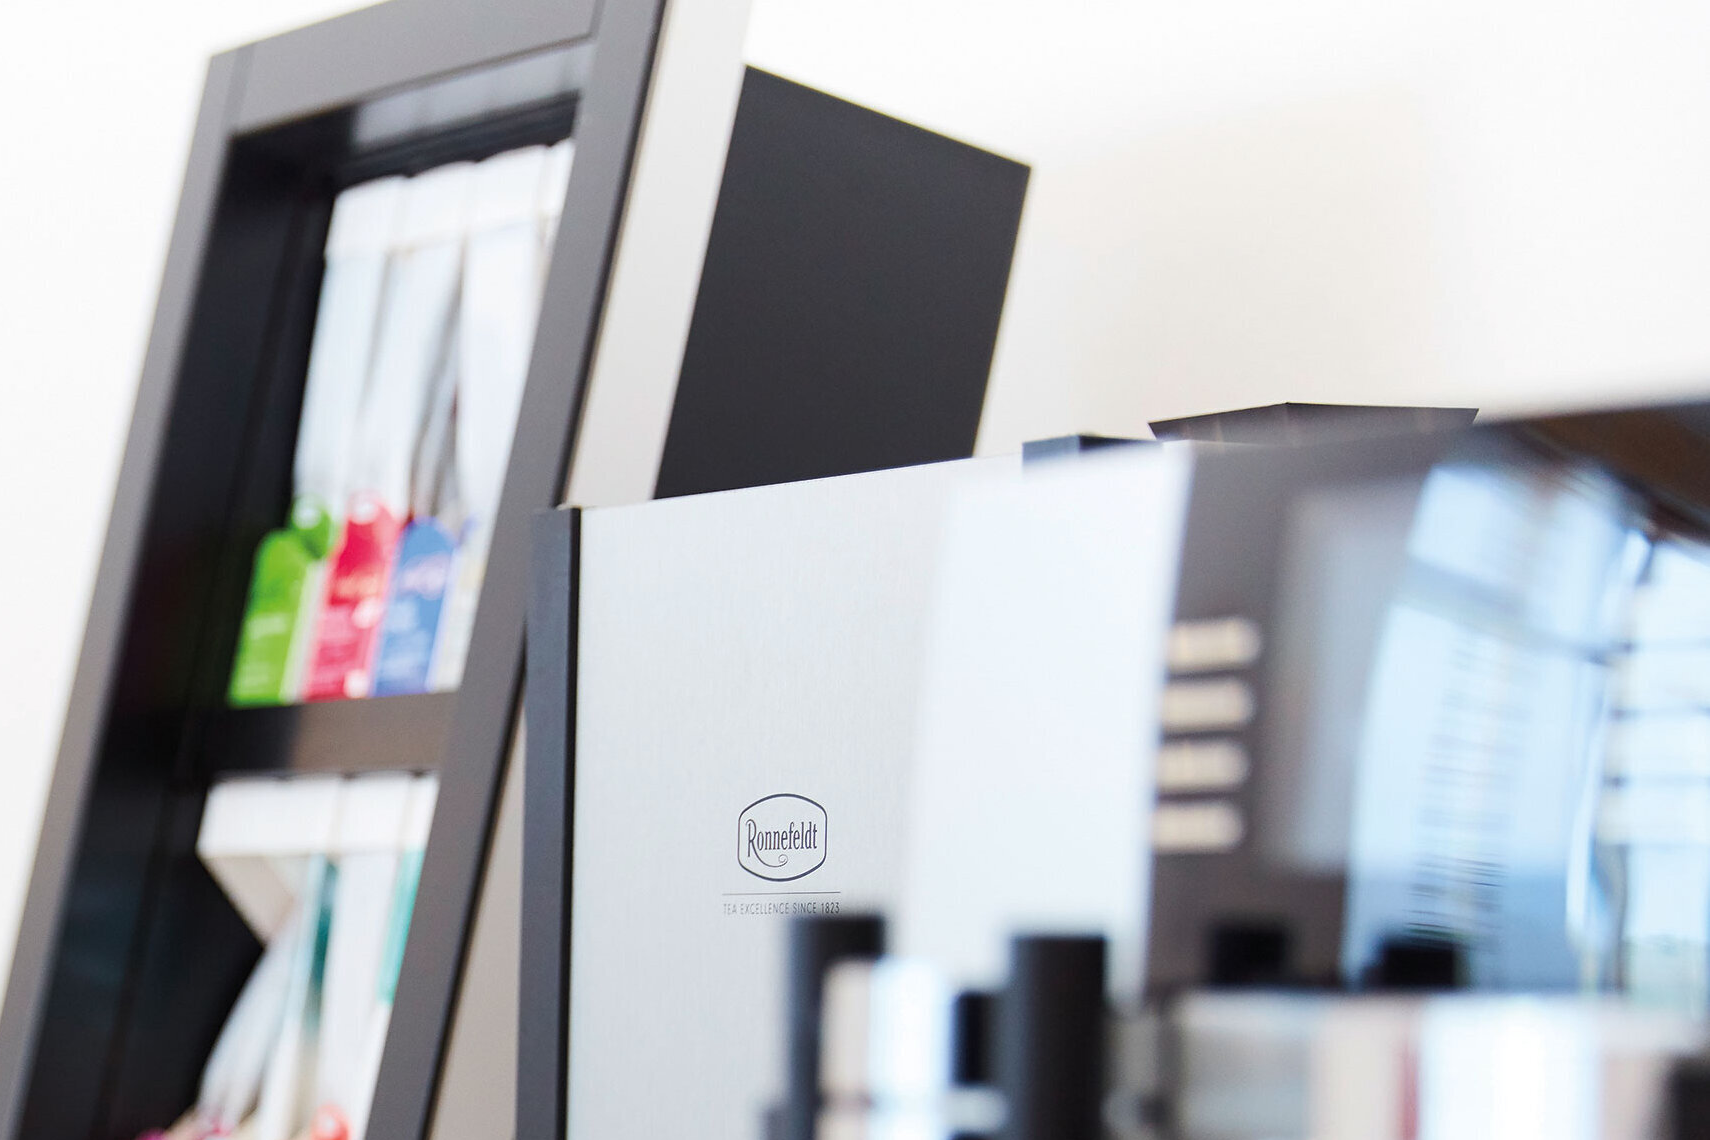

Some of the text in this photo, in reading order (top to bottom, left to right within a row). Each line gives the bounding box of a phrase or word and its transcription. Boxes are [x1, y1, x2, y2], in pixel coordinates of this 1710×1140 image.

[746, 819, 818, 867] Ronnefeldt
[723, 902, 840, 914] TEA EXCELLENCE SINCE 1823
